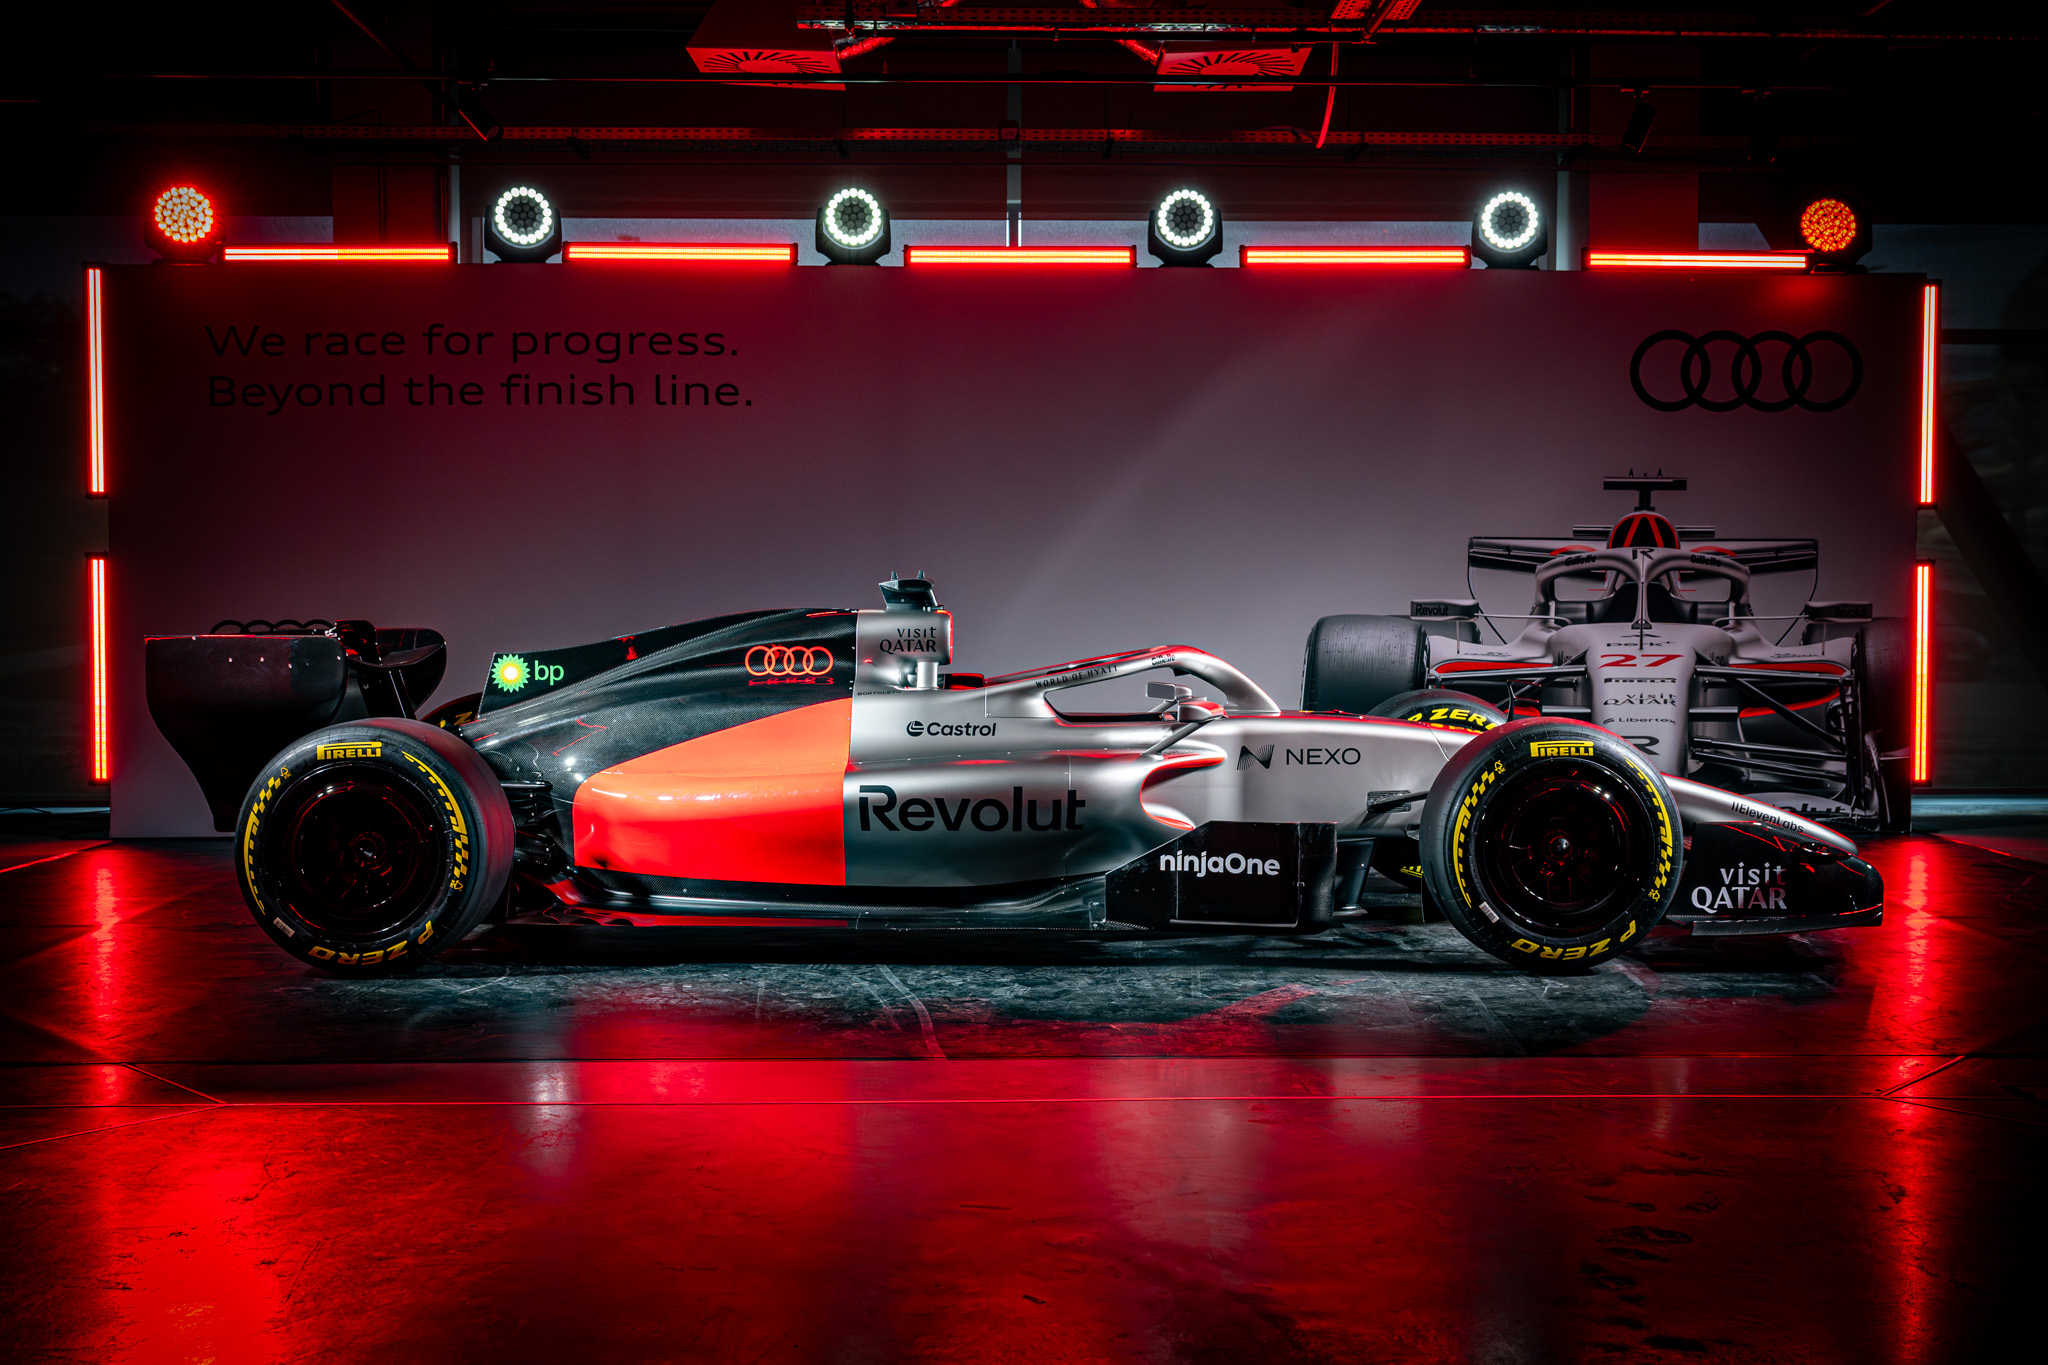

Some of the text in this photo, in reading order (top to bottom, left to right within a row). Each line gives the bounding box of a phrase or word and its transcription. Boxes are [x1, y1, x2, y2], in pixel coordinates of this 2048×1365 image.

[205, 323, 739, 364] We race for progress.
[208, 374, 753, 416] Beyond the finish line.
[1415, 604, 1449, 616] Revolut
[1834, 606, 1868, 618] Revolut
[879, 639, 937, 654] QATAR
[534, 660, 565, 685] bp
[1597, 654, 1685, 671] 27
[1035, 665, 1118, 689] WORLD OF HYATT
[1603, 698, 1677, 707] QATAR
[926, 722, 997, 737] Castrol
[1618, 717, 1676, 725] Libertex
[316, 741, 382, 761] PIRELLI
[1285, 747, 1362, 766] NEXO
[1530, 740, 1594, 758] PIRELLI
[858, 784, 1086, 832] Revolut
[1160, 850, 1281, 878] ninjaOne
[1720, 861, 1787, 885] visit
[1691, 886, 1788, 914] QATAR
[308, 940, 408, 966] ZERO
[1511, 938, 1610, 961] ZERO
